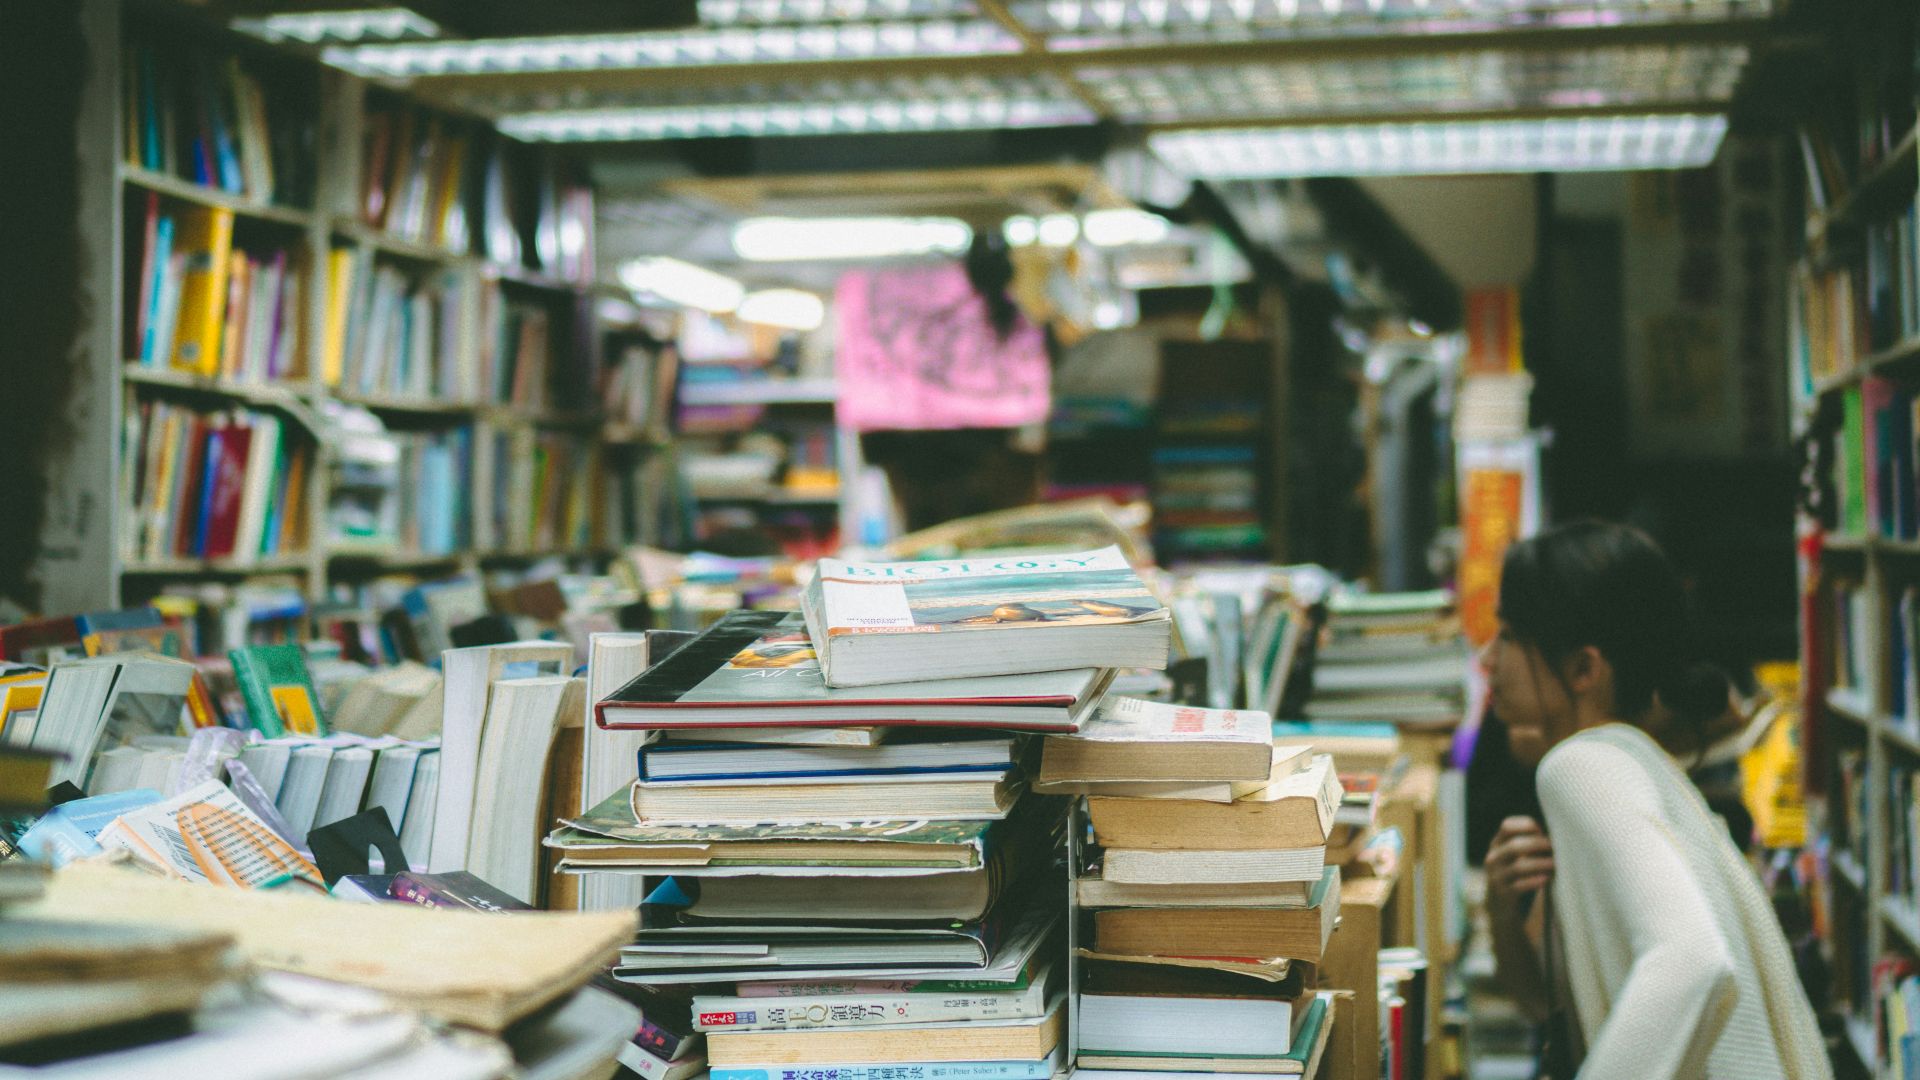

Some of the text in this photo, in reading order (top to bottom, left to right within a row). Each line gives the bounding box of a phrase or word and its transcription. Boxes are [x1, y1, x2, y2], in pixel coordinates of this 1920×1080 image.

[846, 556, 1096, 576] BIOLOGY
[742, 669, 788, 678] All
[768, 1004, 885, 1024] 高EQ領導力
